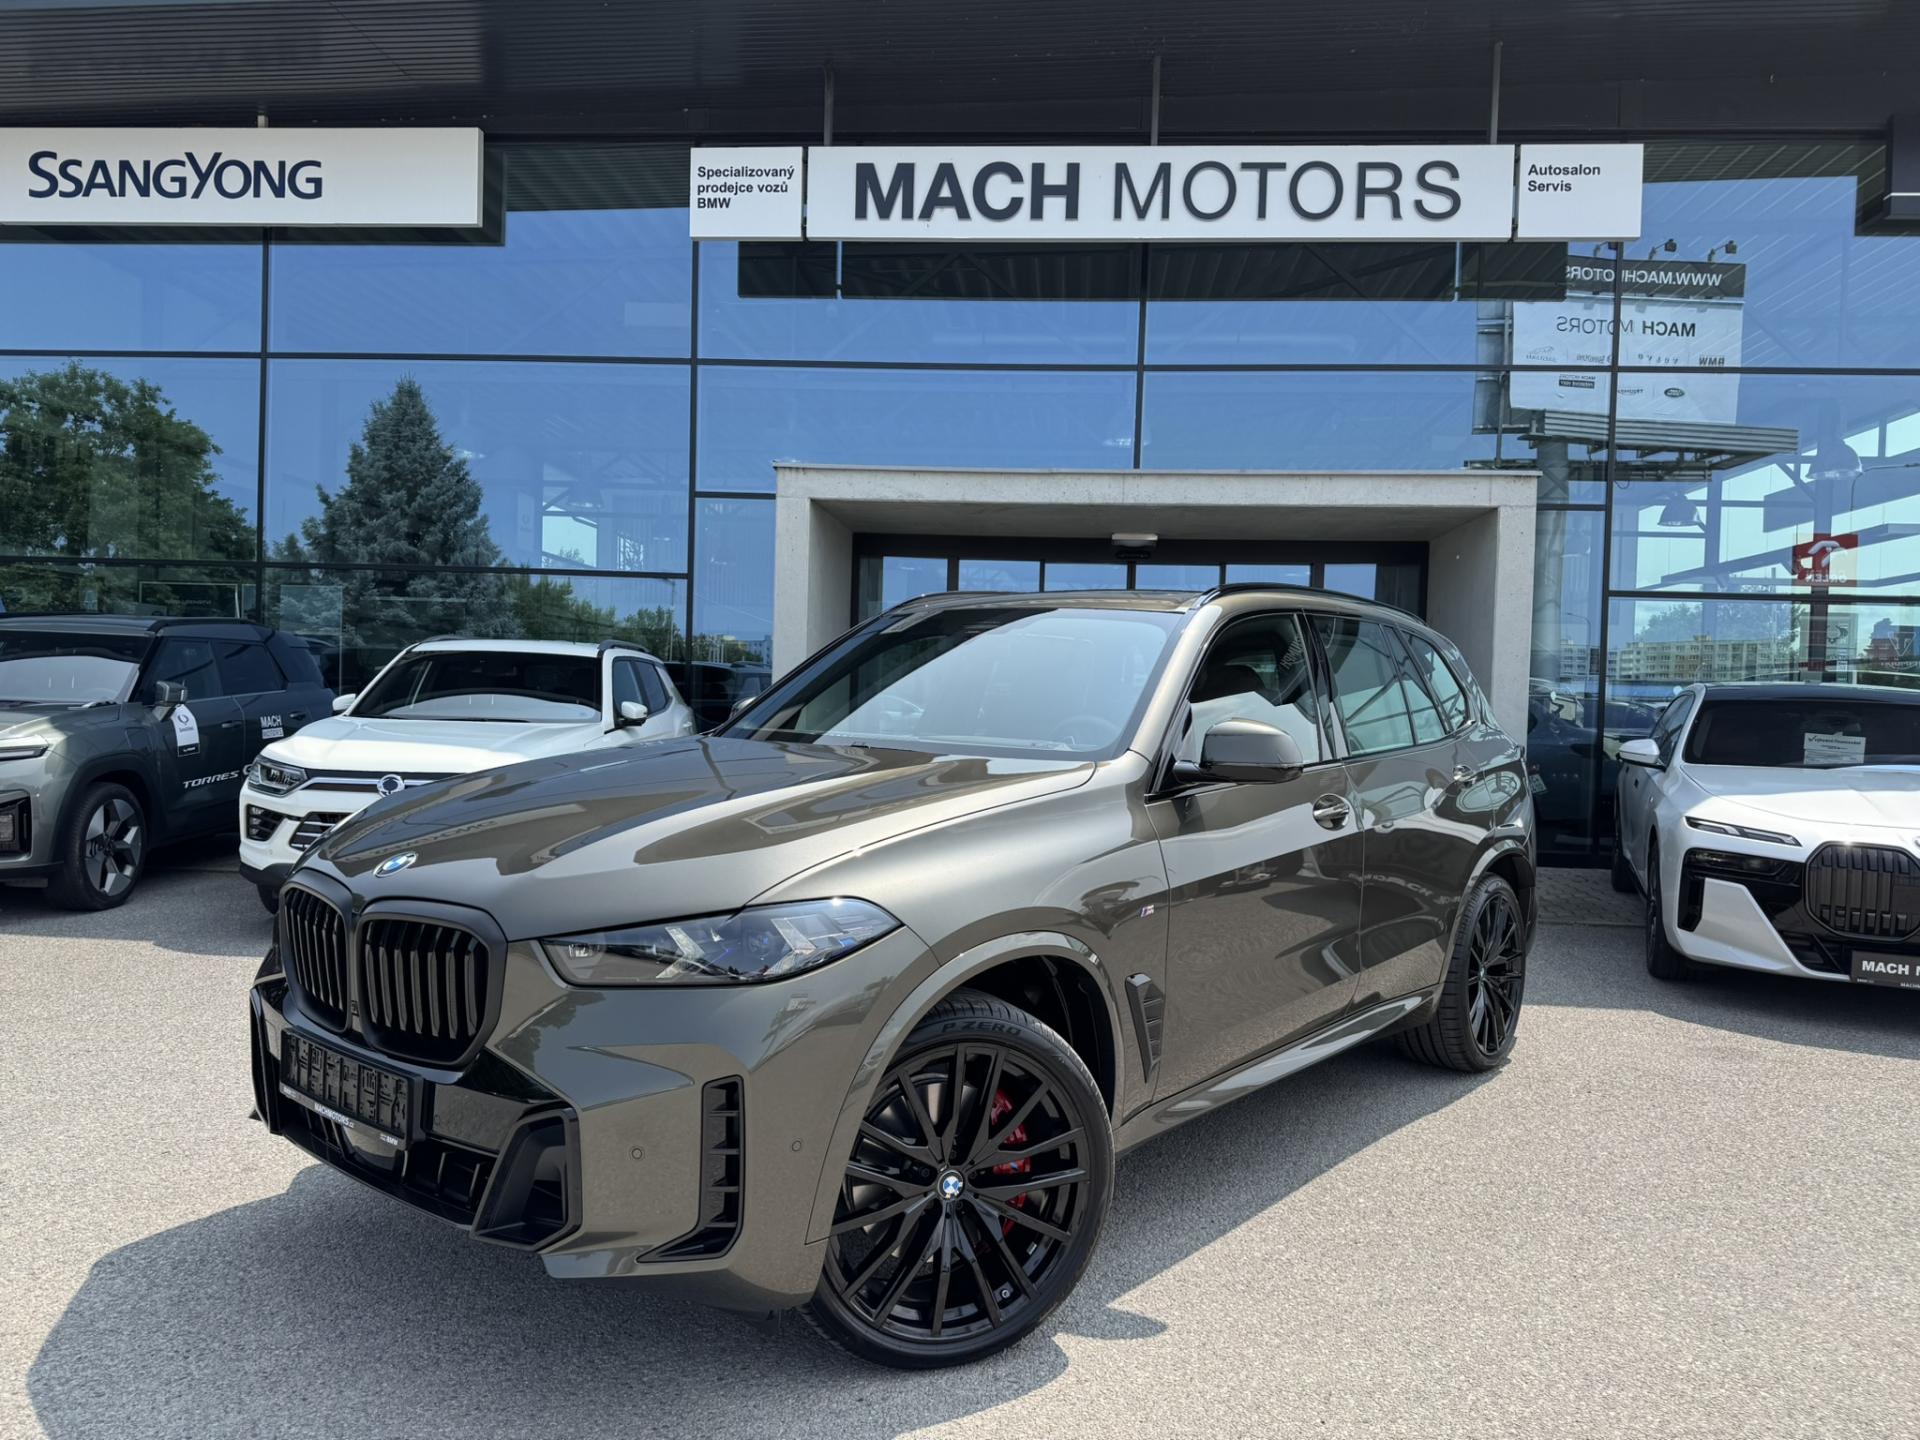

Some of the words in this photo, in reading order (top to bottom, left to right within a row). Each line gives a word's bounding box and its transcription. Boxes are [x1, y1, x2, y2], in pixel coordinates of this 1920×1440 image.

[697, 165, 795, 180] Specializovaný
[1527, 163, 1601, 176] Autosalon
[697, 181, 754, 195] prodejce
[757, 181, 789, 193] vozů
[854, 161, 1081, 221] MACH
[1113, 160, 1461, 221] MOTORS
[1527, 179, 1572, 192] Servis
[697, 197, 731, 209] BMW
[183, 770, 240, 788] TORRES
[1862, 960, 1910, 976] MACH
